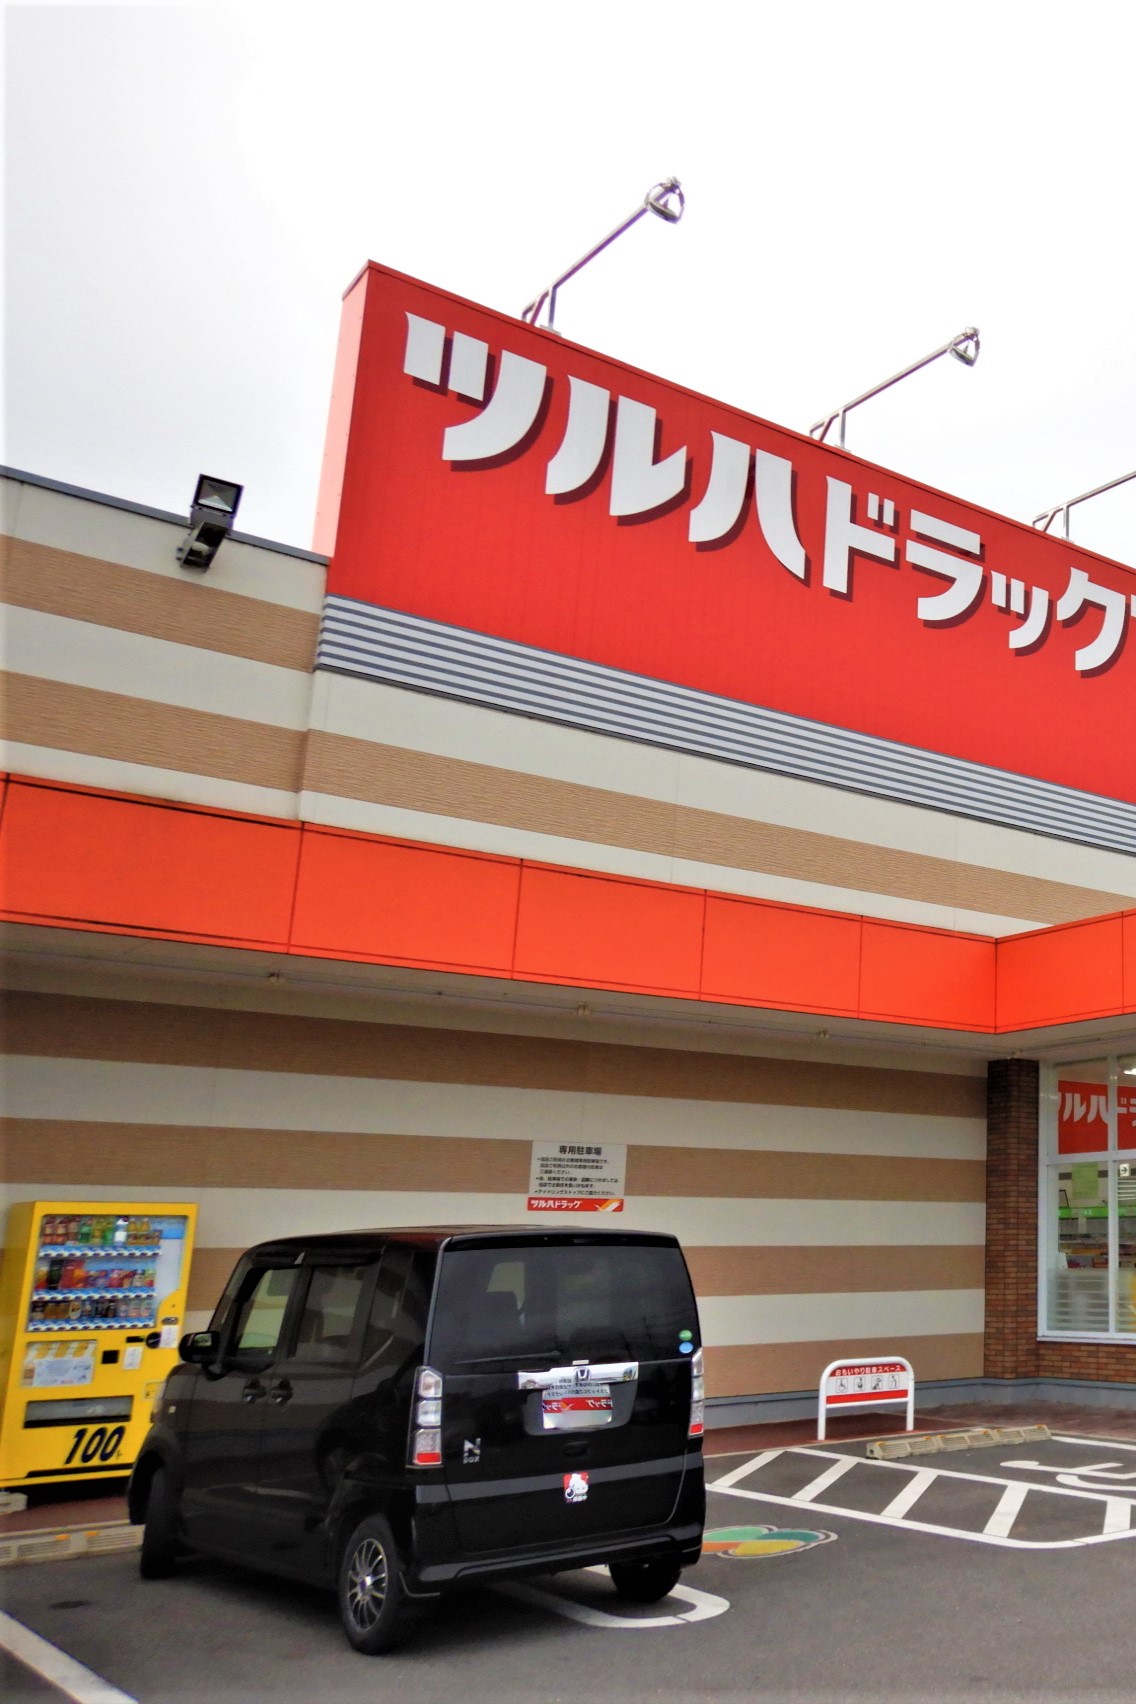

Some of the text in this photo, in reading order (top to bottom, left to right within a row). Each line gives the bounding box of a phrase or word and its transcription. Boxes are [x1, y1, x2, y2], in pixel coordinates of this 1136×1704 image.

[559, 1145, 602, 1156] 専用駐車場
[530, 1199, 583, 1209] ツルハドラッグ
[65, 1426, 126, 1464] 100
[463, 1438, 481, 1456] N
